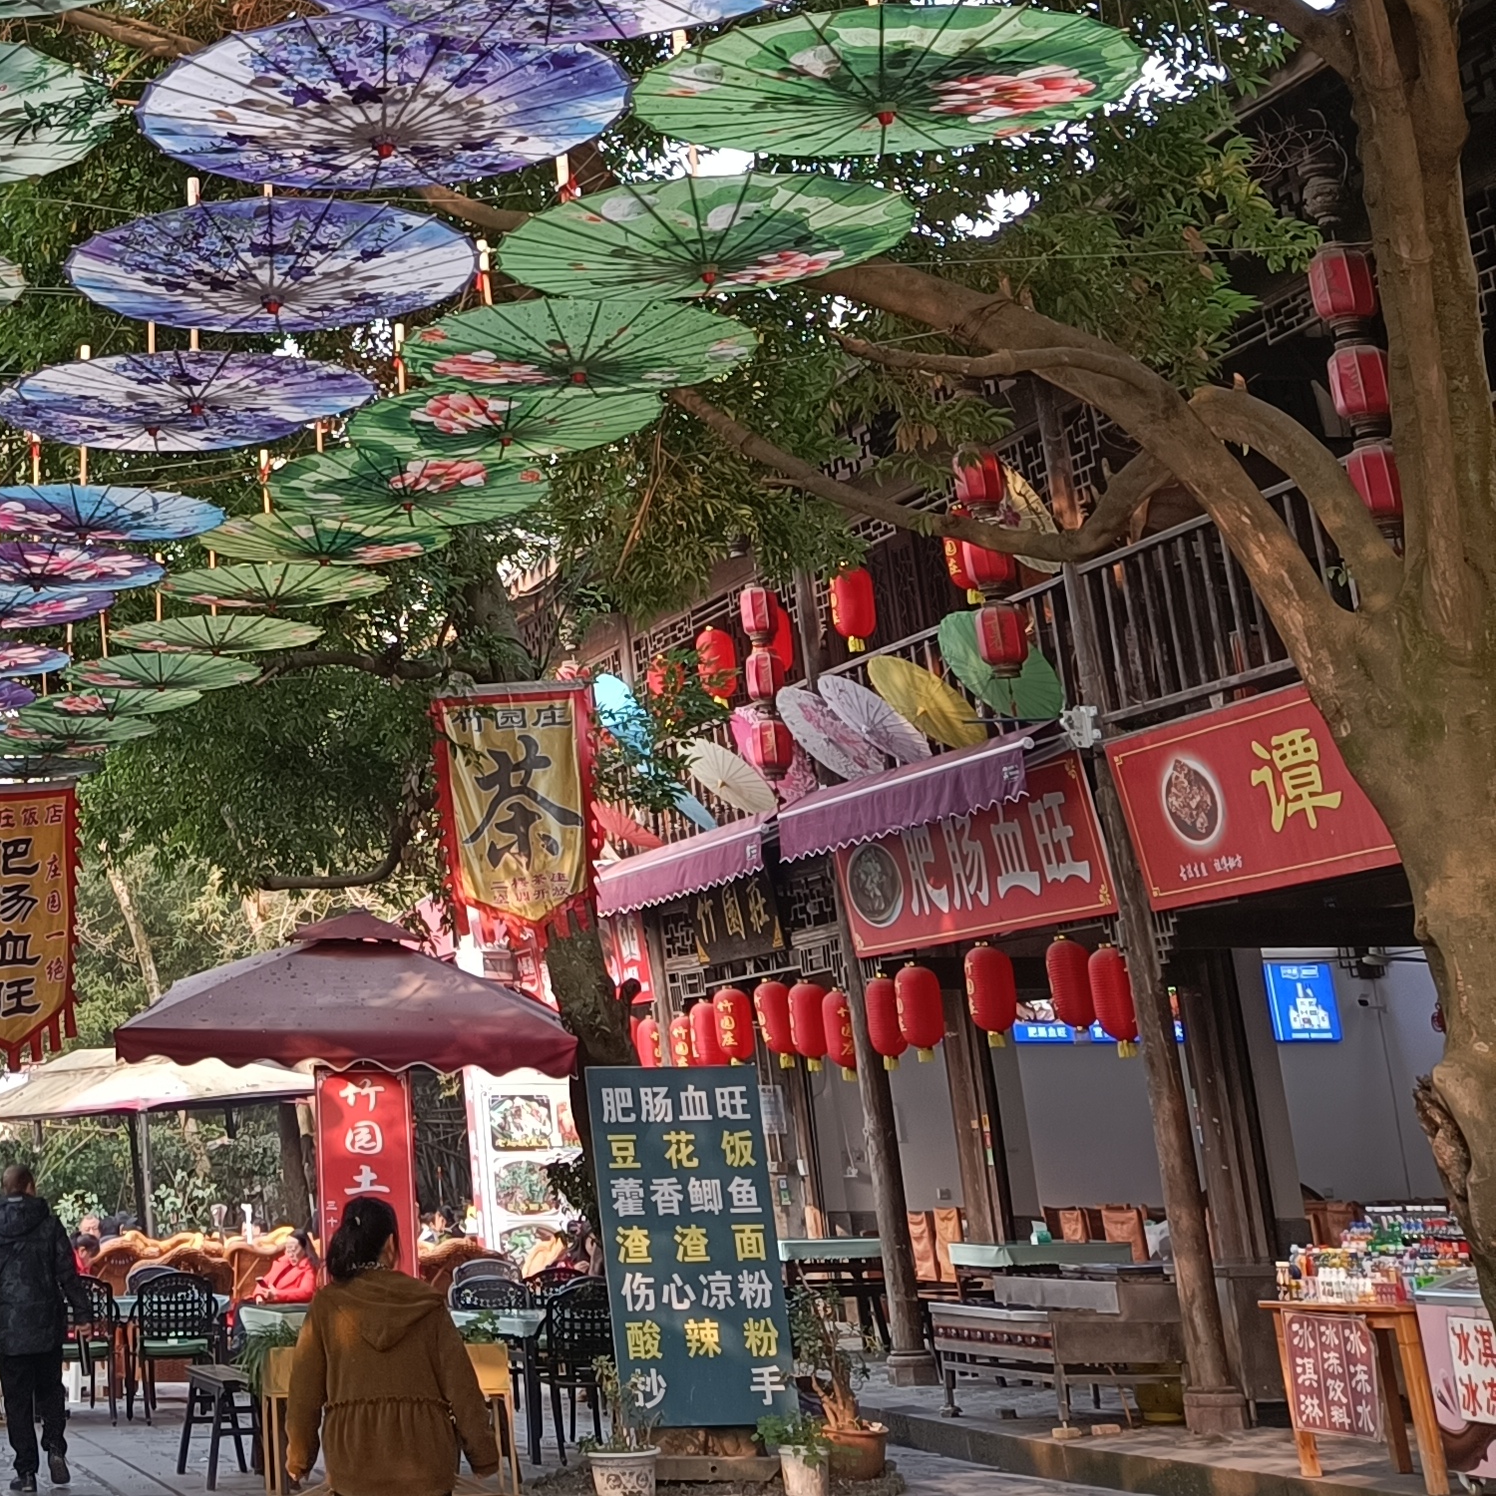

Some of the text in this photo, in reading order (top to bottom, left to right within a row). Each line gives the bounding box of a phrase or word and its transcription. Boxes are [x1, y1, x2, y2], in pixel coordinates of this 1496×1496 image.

[452, 704, 572, 732] 竹园庄
[462, 734, 584, 871] 茶
[900, 791, 1092, 917] 肥肠血旺
[717, 998, 738, 1047] 竹园庄
[601, 1084, 752, 1124] 肥肠血旺
[607, 1129, 757, 1171] 豆花饭
[610, 1175, 763, 1218] 藿香鲫鱼
[615, 1223, 768, 1265] 渣渣面
[621, 1268, 774, 1313] 伤心凉粉
[625, 1316, 780, 1361] 酸辣粉
[1291, 1320, 1324, 1427] 冰淇淋
[1319, 1323, 1352, 1431] 冰冻饮料
[1343, 1327, 1376, 1433] 冰冻水
